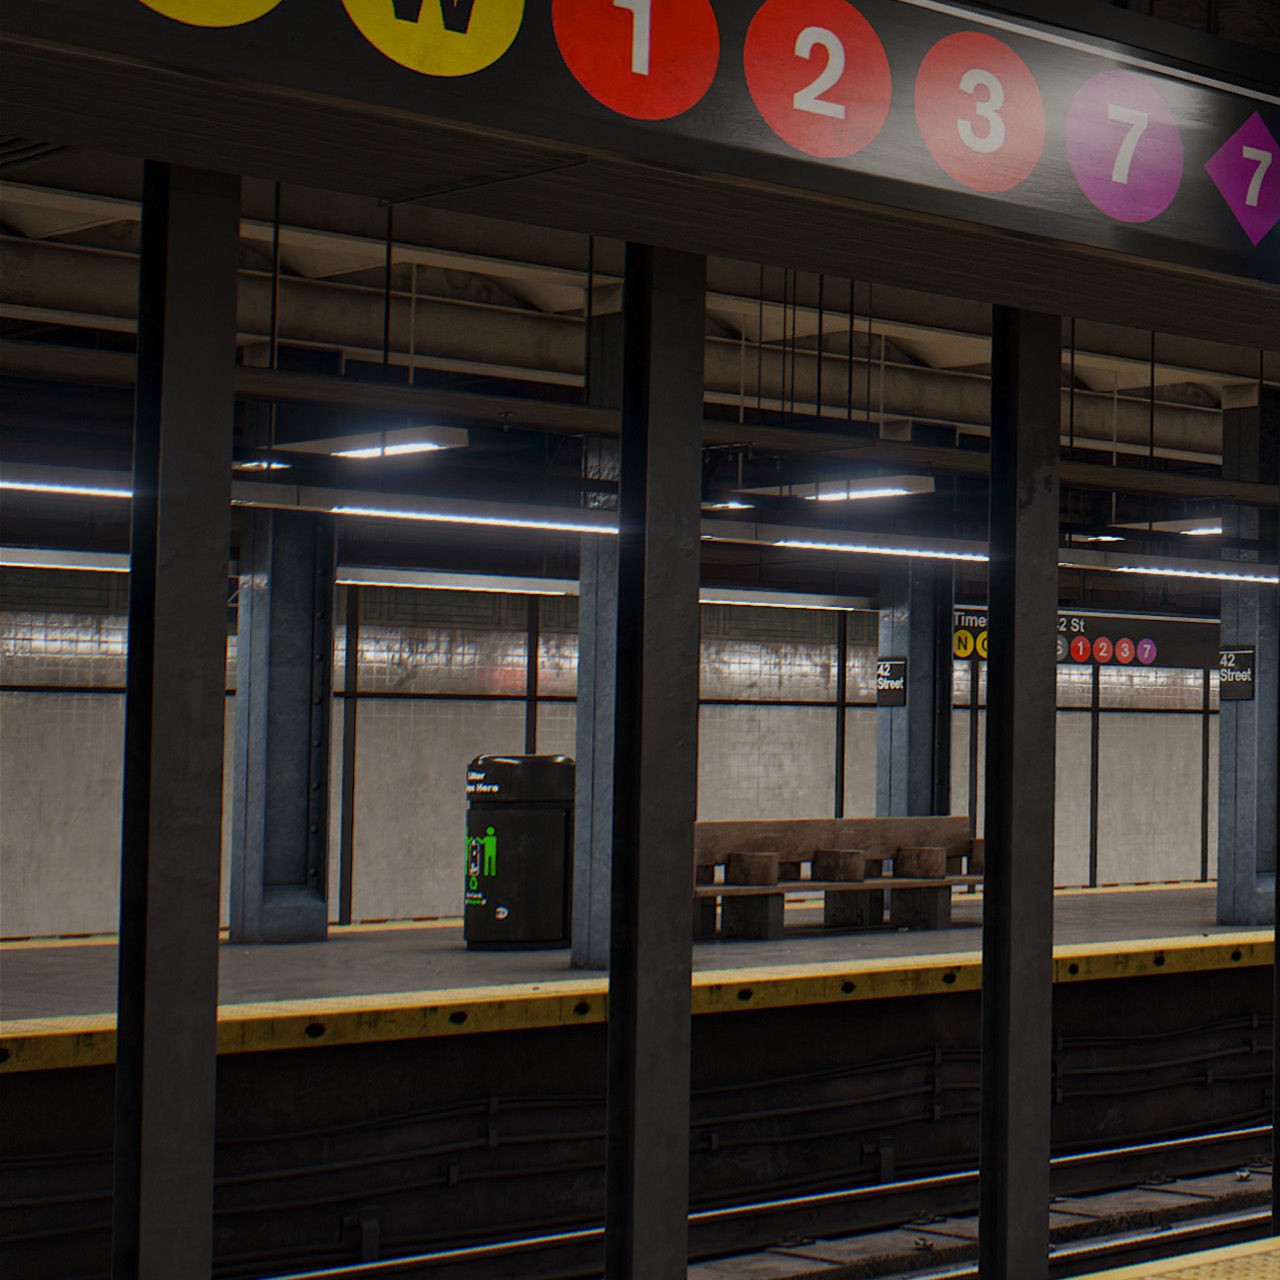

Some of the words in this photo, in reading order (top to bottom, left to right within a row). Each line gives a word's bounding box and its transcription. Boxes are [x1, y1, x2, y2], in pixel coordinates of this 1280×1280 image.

[793, 25, 848, 120] 2
[957, 68, 1006, 154] 3
[1106, 103, 1150, 185] 7
[1241, 146, 1273, 207] 7
[953, 611, 988, 628] Time
[1057, 617, 1067, 632] 2
[1070, 618, 1085, 633] St
[1220, 653, 1236, 668] 42
[877, 664, 891, 677] 42
[1220, 668, 1253, 682] Street
